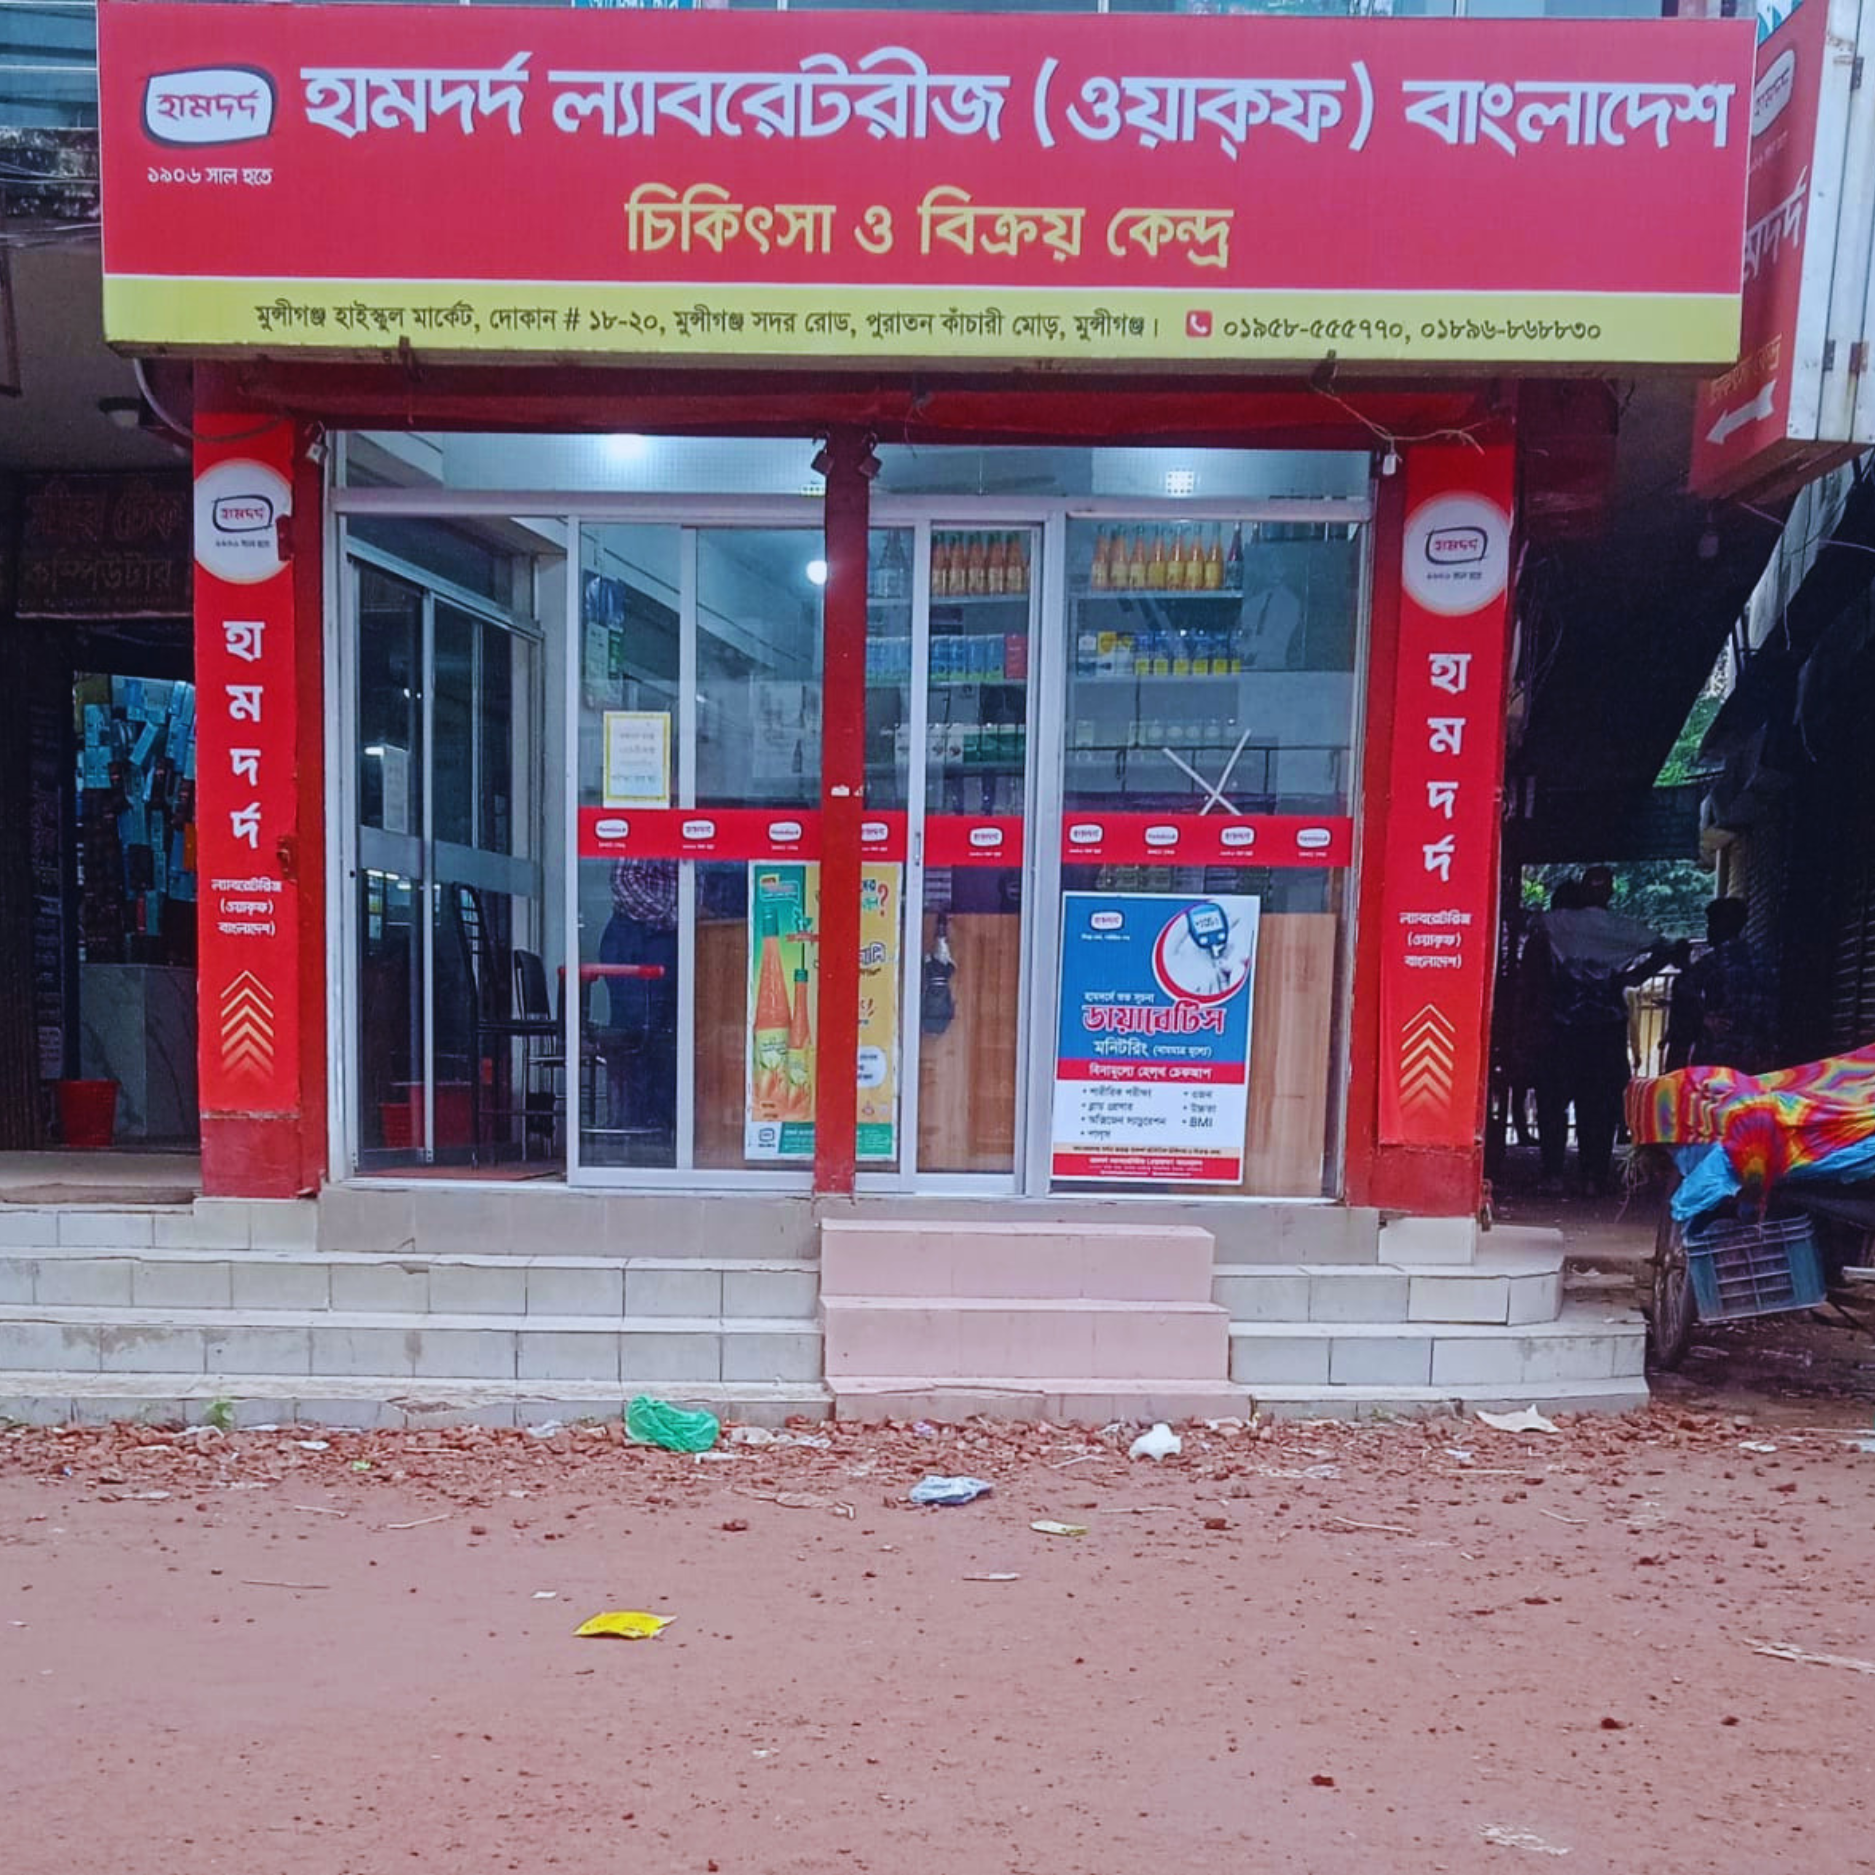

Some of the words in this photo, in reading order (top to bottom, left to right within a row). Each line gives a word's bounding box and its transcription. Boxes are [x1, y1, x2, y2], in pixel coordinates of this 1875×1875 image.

[156, 89, 260, 121] হামদর্দ
[300, 51, 532, 138] হামদর্দ
[548, 46, 1010, 141] ল্যাবরেটরীজ
[1402, 80, 1735, 156] বাংলাদেশ
[147, 167, 202, 183] ১৯০৬
[205, 167, 238, 185] সাল
[242, 167, 273, 186] হতে
[626, 183, 835, 254] চিকিৎসা
[855, 206, 893, 255] ও
[917, 186, 1086, 261] বিক্রয়
[1108, 208, 1235, 268] কেন্দ্র
[254, 298, 326, 331] মুন্সীগঞ্জ
[333, 300, 405, 333] হাইস্কুল
[412, 300, 481, 333] মার্কেট,
[489, 308, 557, 331] দোকান
[564, 307, 580, 331] #
[590, 310, 666, 335] ১৮-২০,
[673, 304, 744, 336] মুন্সীগঞ্জ
[752, 312, 796, 332] সদর
[805, 312, 856, 337] রোড,
[865, 311, 934, 339] পুরাতন
[940, 307, 1003, 337] কাঁচারী
[1012, 313, 1066, 340] মোড়,
[1223, 318, 1411, 344] ০১৯৫৮-৫৫৫৭৭০,
[1420, 319, 1602, 340] ০১৮৯৬-৮৬৮৮৩০
[1082, 998, 1228, 1035] ডায়াবেটিস
[1189, 1116, 1214, 1128] BMI
